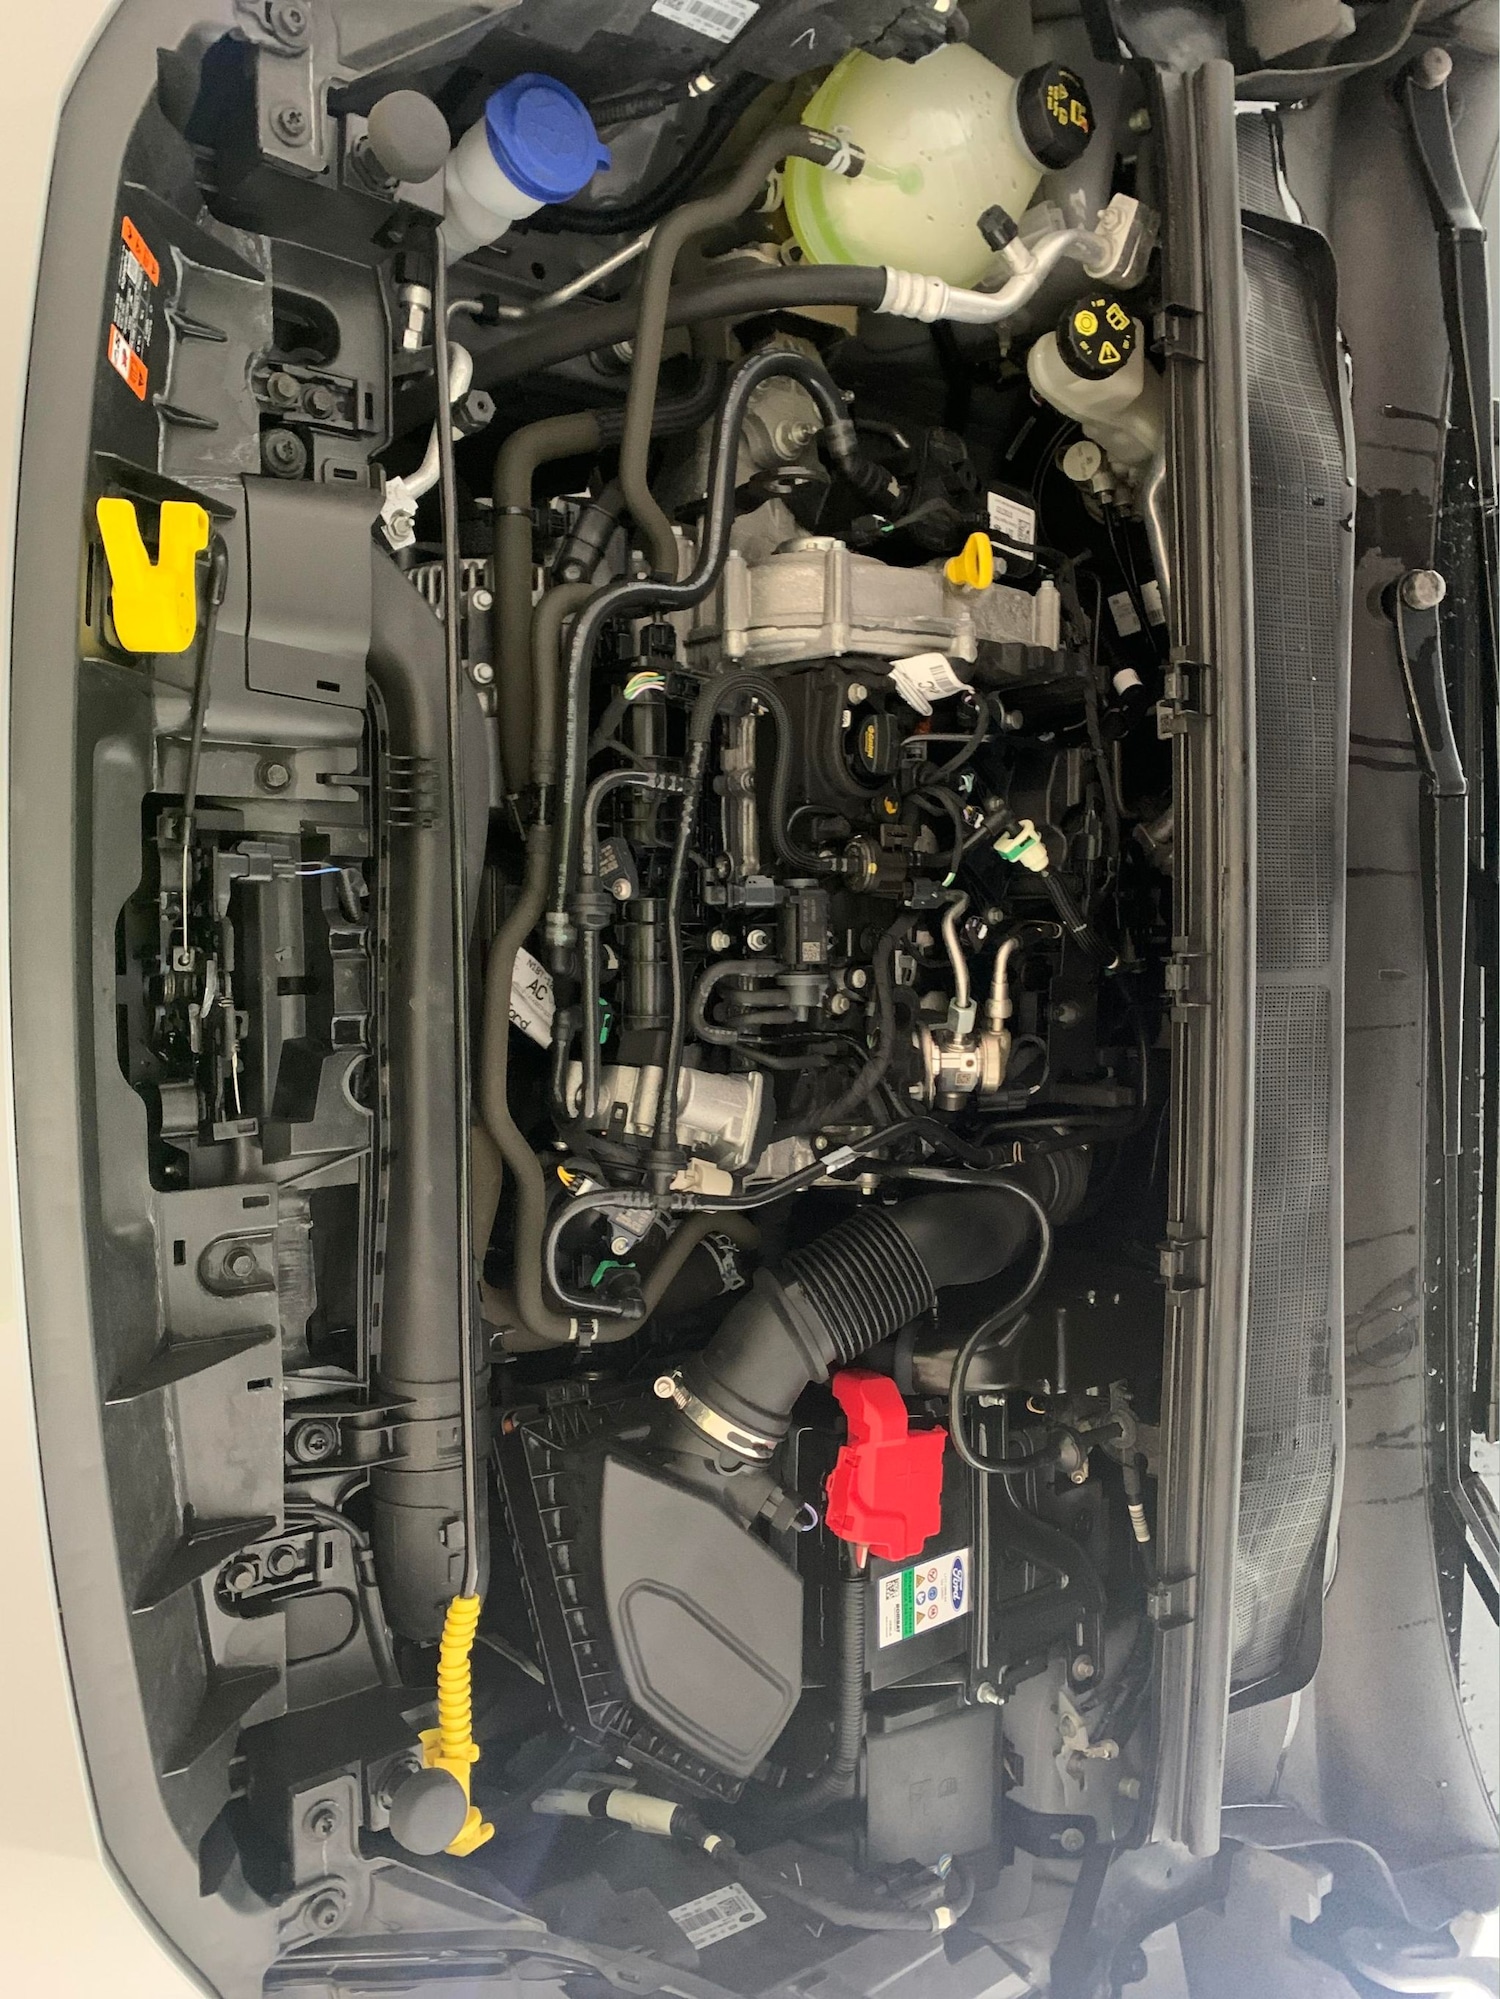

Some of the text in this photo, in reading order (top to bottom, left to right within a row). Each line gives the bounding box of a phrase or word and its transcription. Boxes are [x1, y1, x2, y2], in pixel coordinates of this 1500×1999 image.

[525, 978, 548, 1001] AC
[508, 1003, 532, 1031] ord
[952, 1567, 963, 1601] Ford
